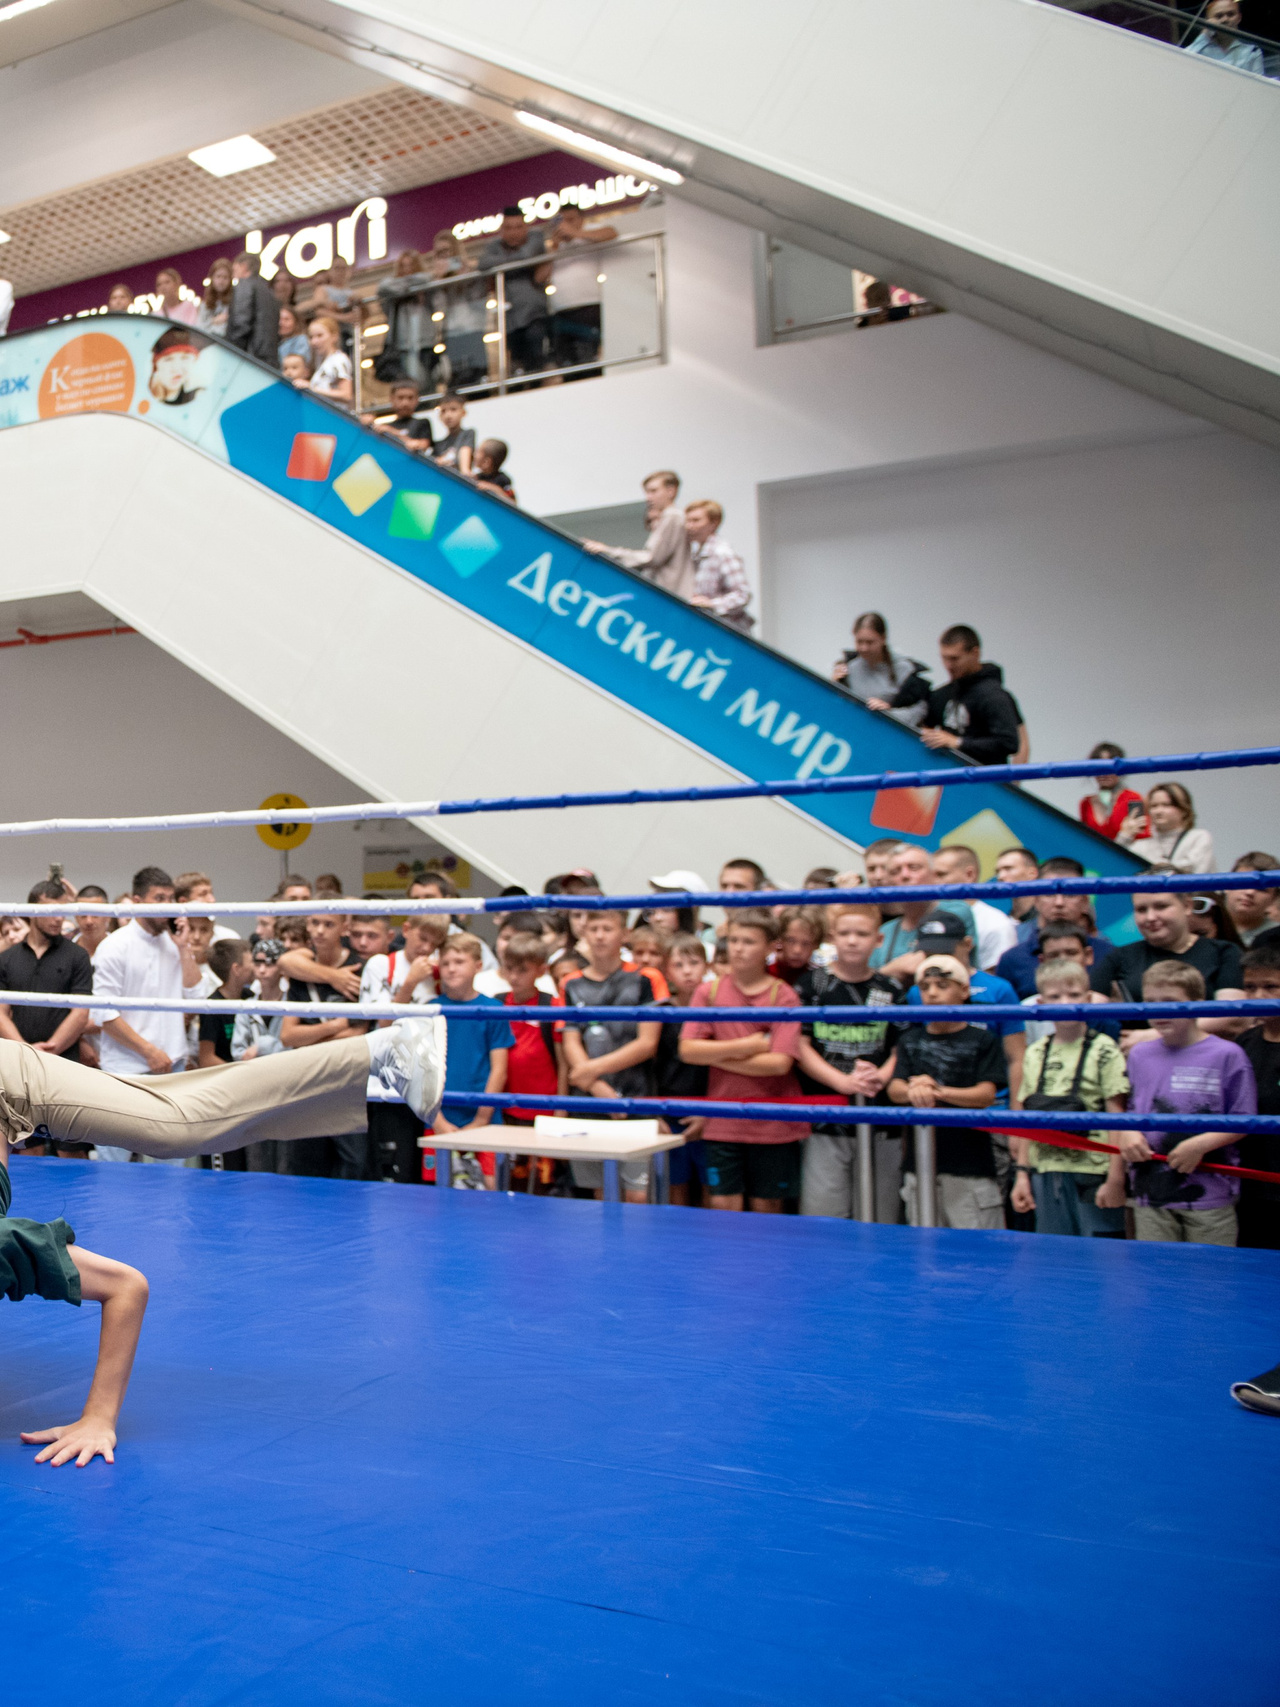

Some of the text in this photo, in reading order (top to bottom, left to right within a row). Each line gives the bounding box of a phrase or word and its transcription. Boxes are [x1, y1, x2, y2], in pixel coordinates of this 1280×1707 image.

[246, 197, 388, 281] kari
[507, 551, 853, 781] Детский мир
